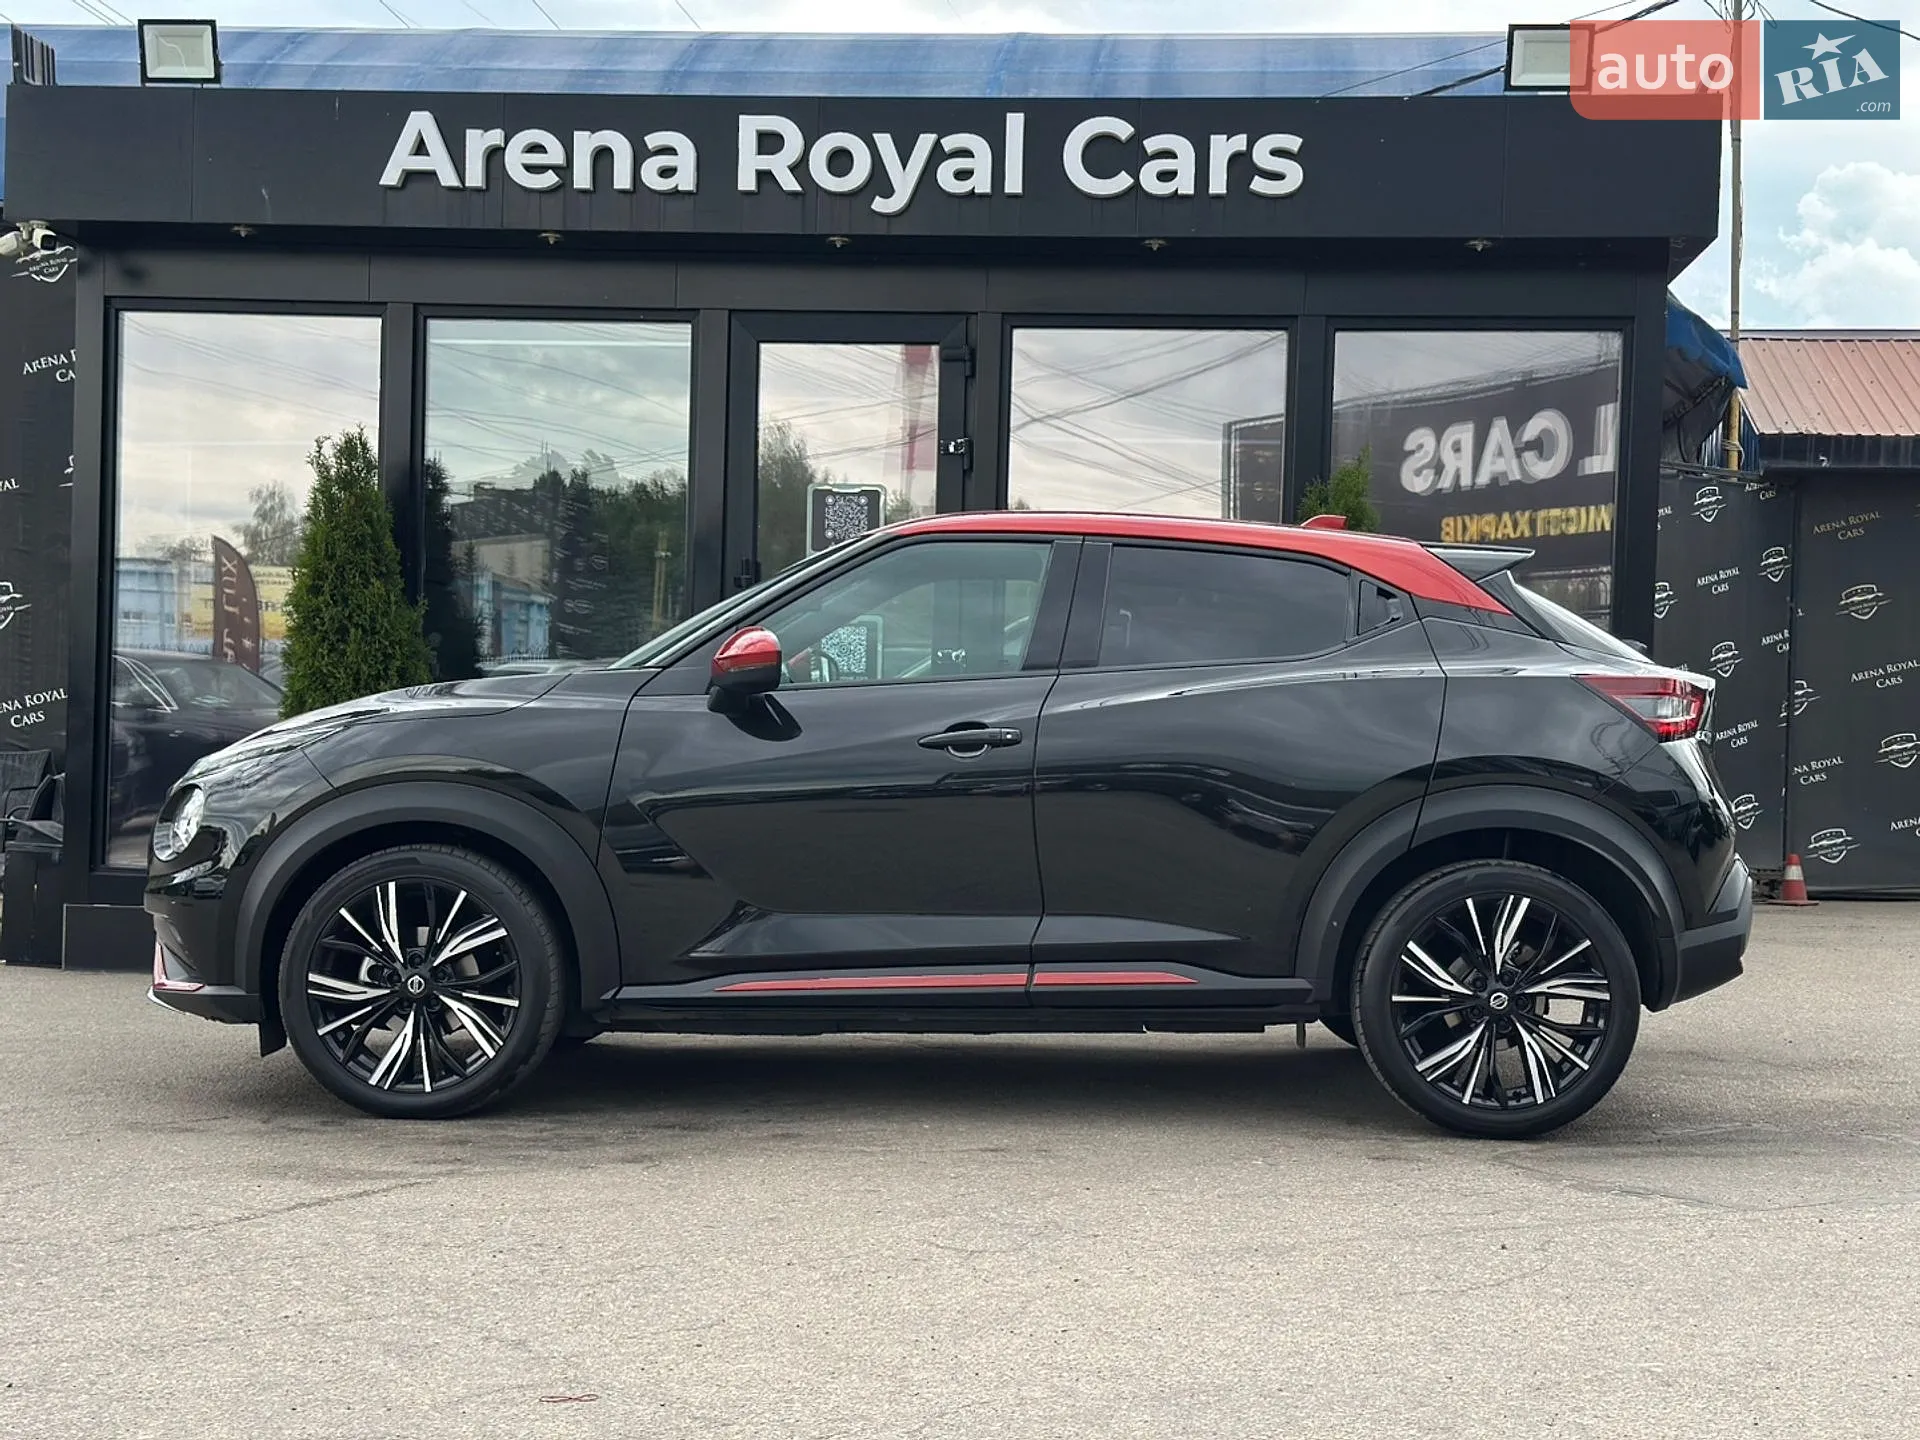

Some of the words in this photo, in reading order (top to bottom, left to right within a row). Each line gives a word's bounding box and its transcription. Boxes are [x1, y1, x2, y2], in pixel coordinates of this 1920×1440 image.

[379, 109, 697, 193] Arena
[736, 111, 1024, 215] Royal
[1062, 116, 1306, 199] Cars
[23, 353, 68, 375] ARENA
[1813, 521, 1847, 534] ARENA
[1848, 511, 1881, 525] ROYAL
[1838, 528, 1865, 540] CARS
[1850, 668, 1885, 682] ARENA
[1886, 660, 1920, 673] ROYAL
[1876, 676, 1903, 688] CARS
[25, 687, 68, 707] ROYAL
[11, 711, 45, 728] CARS
[1792, 765, 1809, 775] NA
[1811, 756, 1844, 770] ROYAL
[1800, 772, 1828, 785] CARS
